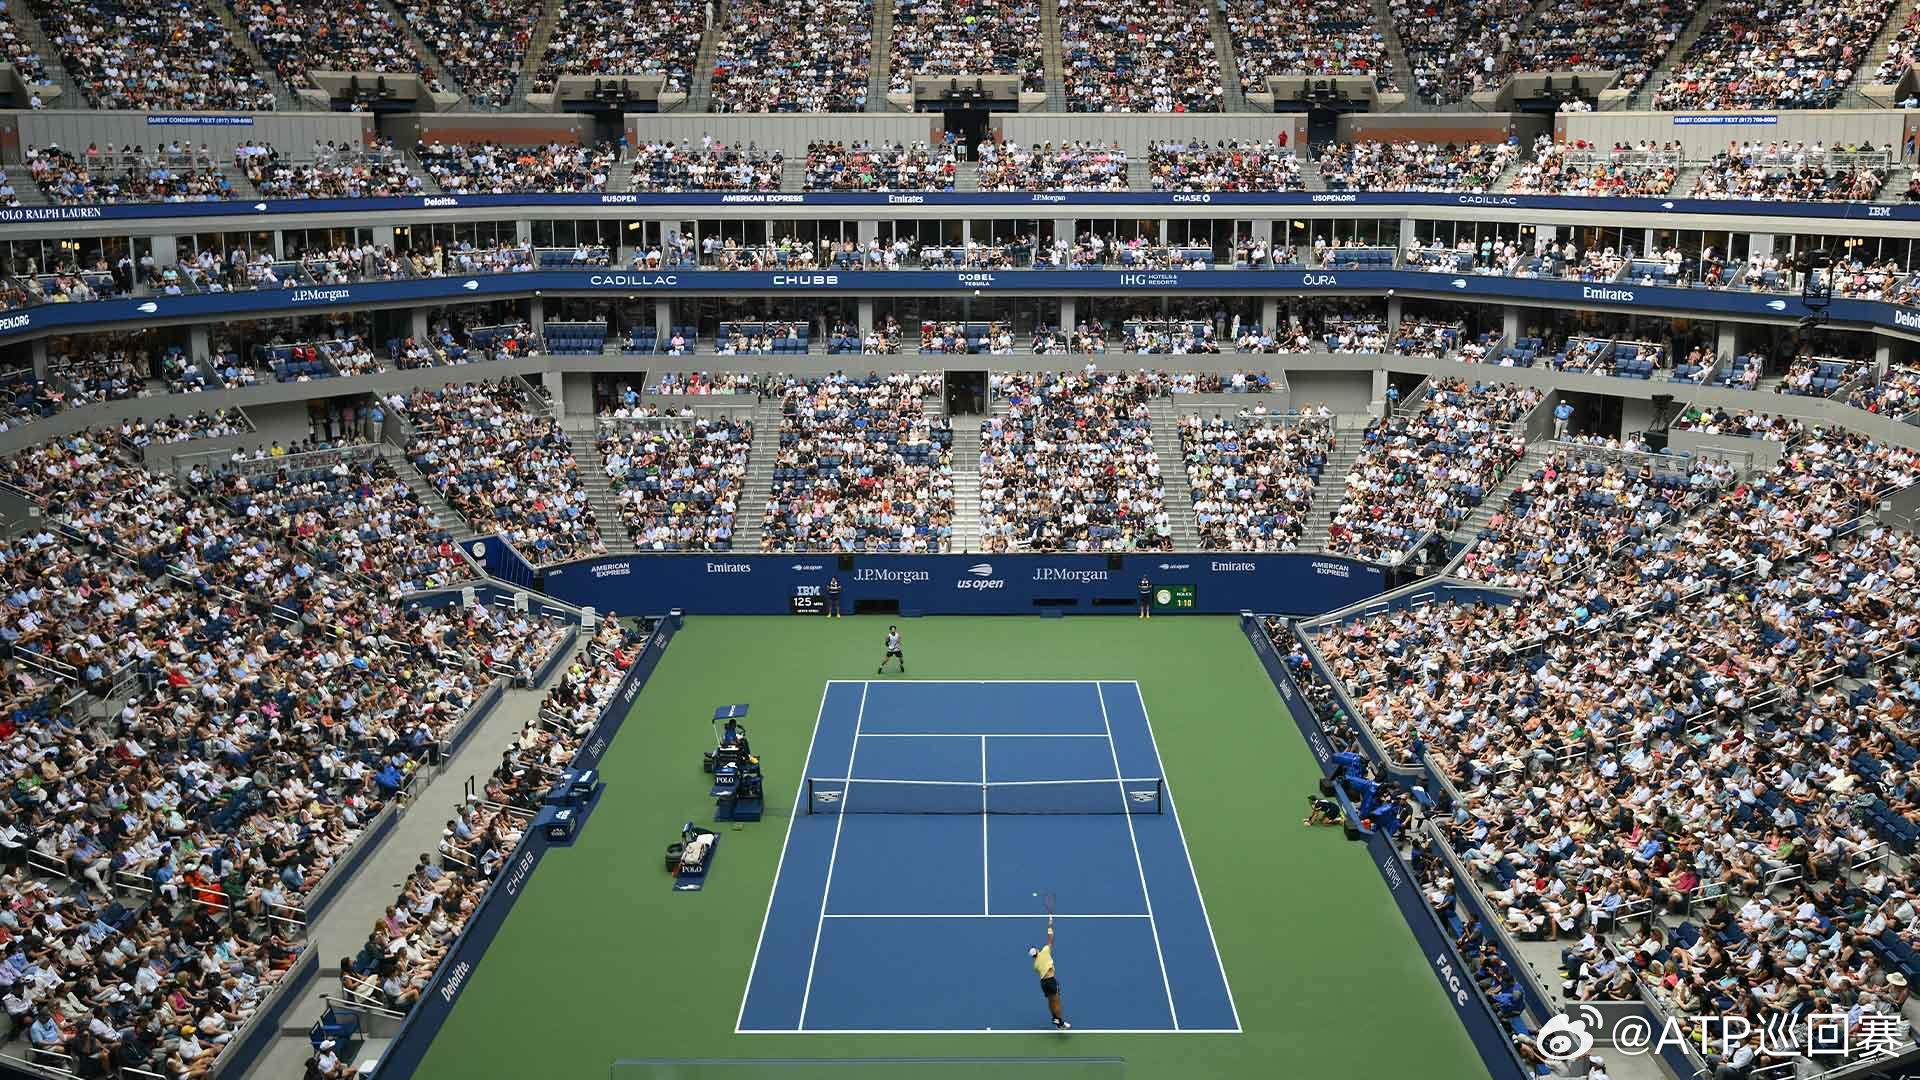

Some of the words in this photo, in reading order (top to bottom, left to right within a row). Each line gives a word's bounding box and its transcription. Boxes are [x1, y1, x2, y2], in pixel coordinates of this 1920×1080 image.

[424, 198, 458, 206] Deloitte.
[889, 194, 923, 203] Emirates
[1032, 194, 1066, 202] J.P.Morgan
[1173, 194, 1201, 202] CHASE
[1312, 194, 1356, 202] USOPEN.ORG
[1458, 195, 1517, 205] CADILLAC
[26, 208, 60, 219] RALPH
[62, 207, 101, 218] LAUREN
[1869, 206, 1891, 217] IBM
[591, 275, 677, 286] CADILLAC
[773, 275, 838, 285] CHUBB
[1120, 275, 1146, 286] IHG
[292, 288, 349, 303] J.P.Morgan
[1583, 286, 1634, 302] Emirates
[591, 562, 630, 573] AMERICAN
[707, 562, 752, 573] Emirates
[1211, 562, 1256, 572] Emirates
[1311, 561, 1350, 572] AMERICAN
[596, 569, 631, 578] EXPRESS
[854, 568, 929, 583] J.P.Morgan
[1033, 568, 1108, 583] J.P.Morgan
[1316, 568, 1350, 578] EXPRESS
[957, 579, 972, 590] us
[973, 579, 1004, 591] open
[797, 586, 821, 596] IBM
[794, 597, 812, 607] 125
[624, 677, 642, 703] FAGE
[1309, 731, 1329, 763] CHUBB
[506, 851, 534, 896] CHUBB
[1383, 855, 1402, 890] Harvey
[440, 961, 470, 1002] Deloitte.
[1436, 952, 1469, 1007] FAGE
